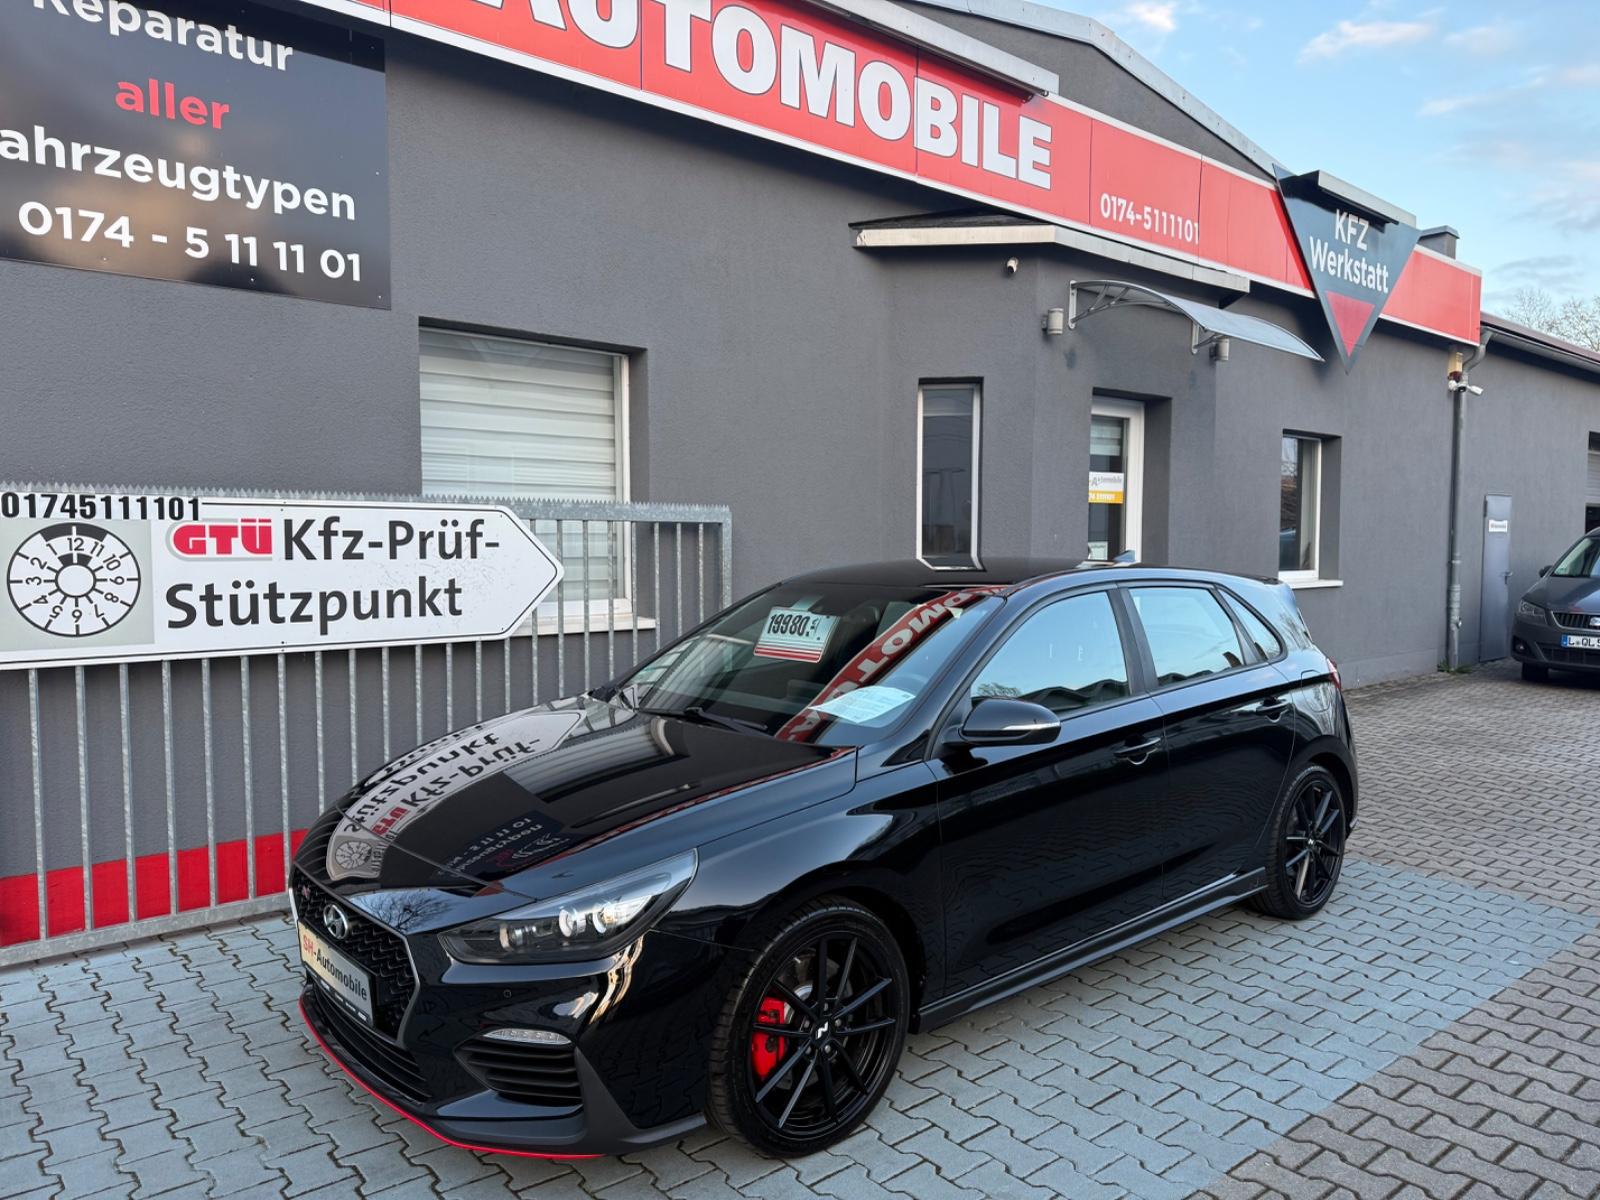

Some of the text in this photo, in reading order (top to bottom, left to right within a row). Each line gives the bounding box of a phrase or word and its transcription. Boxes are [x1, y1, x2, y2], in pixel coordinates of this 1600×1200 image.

[468, 0, 1053, 190] UTOMOBILE
[115, 78, 230, 129] aller
[1100, 193, 1199, 245] 0174-5111101
[1335, 208, 1369, 251] KFZ
[18, 201, 134, 248] 0174
[185, 226, 209, 259] 5
[225, 233, 257, 267] 11
[273, 241, 305, 274] 11
[320, 249, 361, 282] 01
[1309, 236, 1389, 294] Werkstatt
[1, 491, 200, 521] 01745111101
[67, 537, 85, 551] 12
[173, 516, 500, 560] GTÜ Kfz-Prüf-
[46, 543, 57, 556] 1
[91, 541, 105, 557] 11
[30, 557, 48, 570] 2
[103, 554, 121, 571] 10
[25, 576, 42, 586] 3
[110, 576, 125, 585] 9
[33, 595, 49, 604] 4
[104, 592, 119, 603] 8
[165, 576, 463, 635] Stützpunkt
[50, 605, 63, 619] 5
[71, 609, 83, 623] 6
[94, 604, 104, 618] 7
[302, 934, 367, 1001] SH-Automobile
